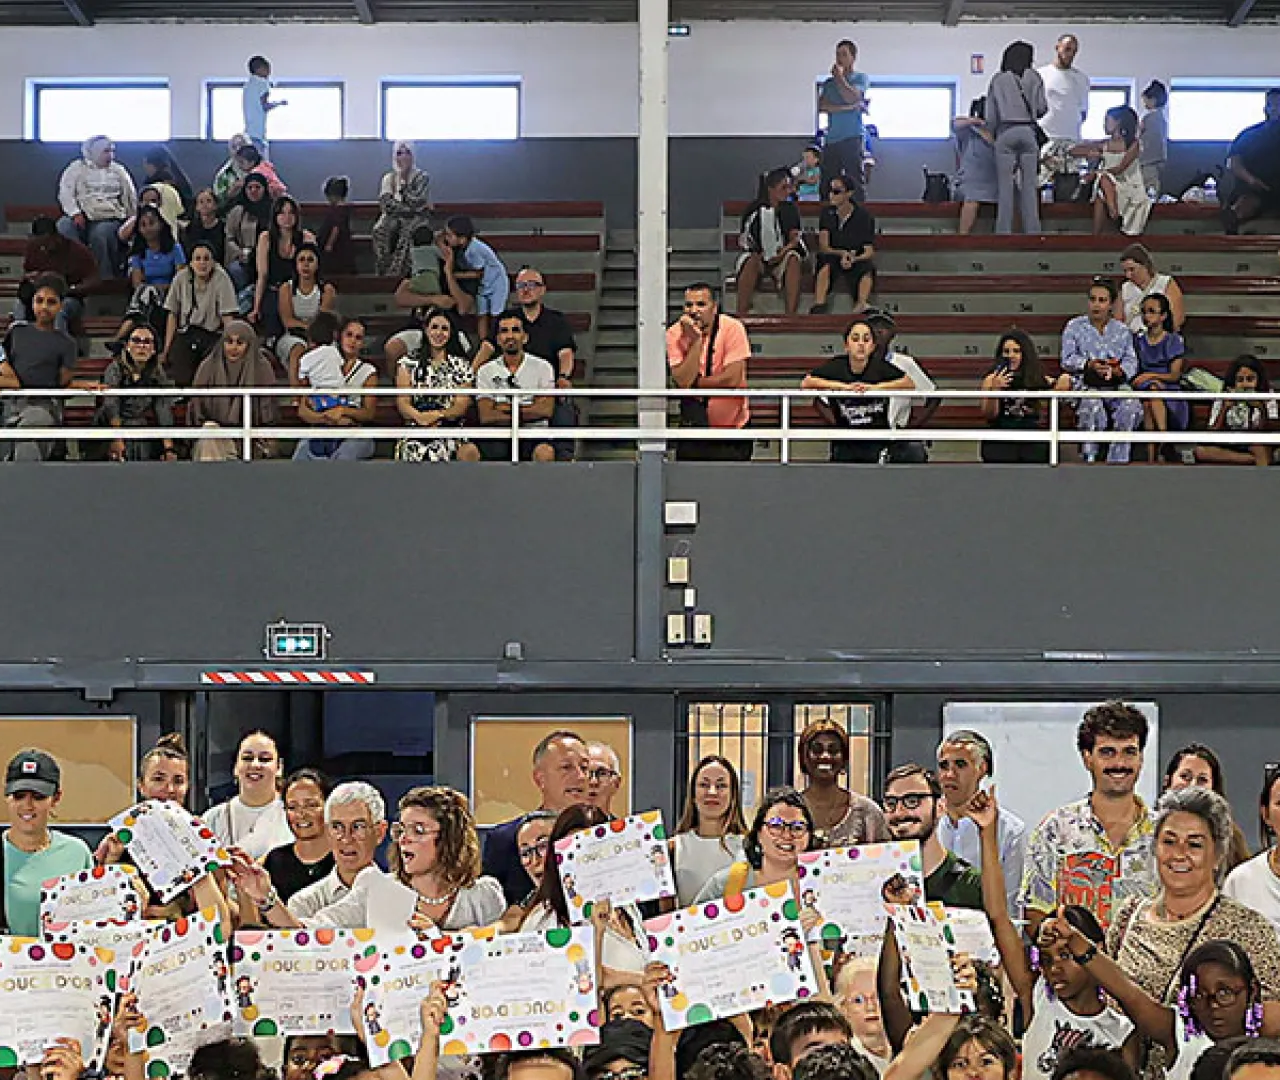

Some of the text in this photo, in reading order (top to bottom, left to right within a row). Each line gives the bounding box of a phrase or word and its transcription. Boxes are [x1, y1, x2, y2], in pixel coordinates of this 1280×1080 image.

[732, 920, 769, 942] D'OR
[315, 957, 350, 972] D'OR
[55, 974, 93, 991] D'OR
